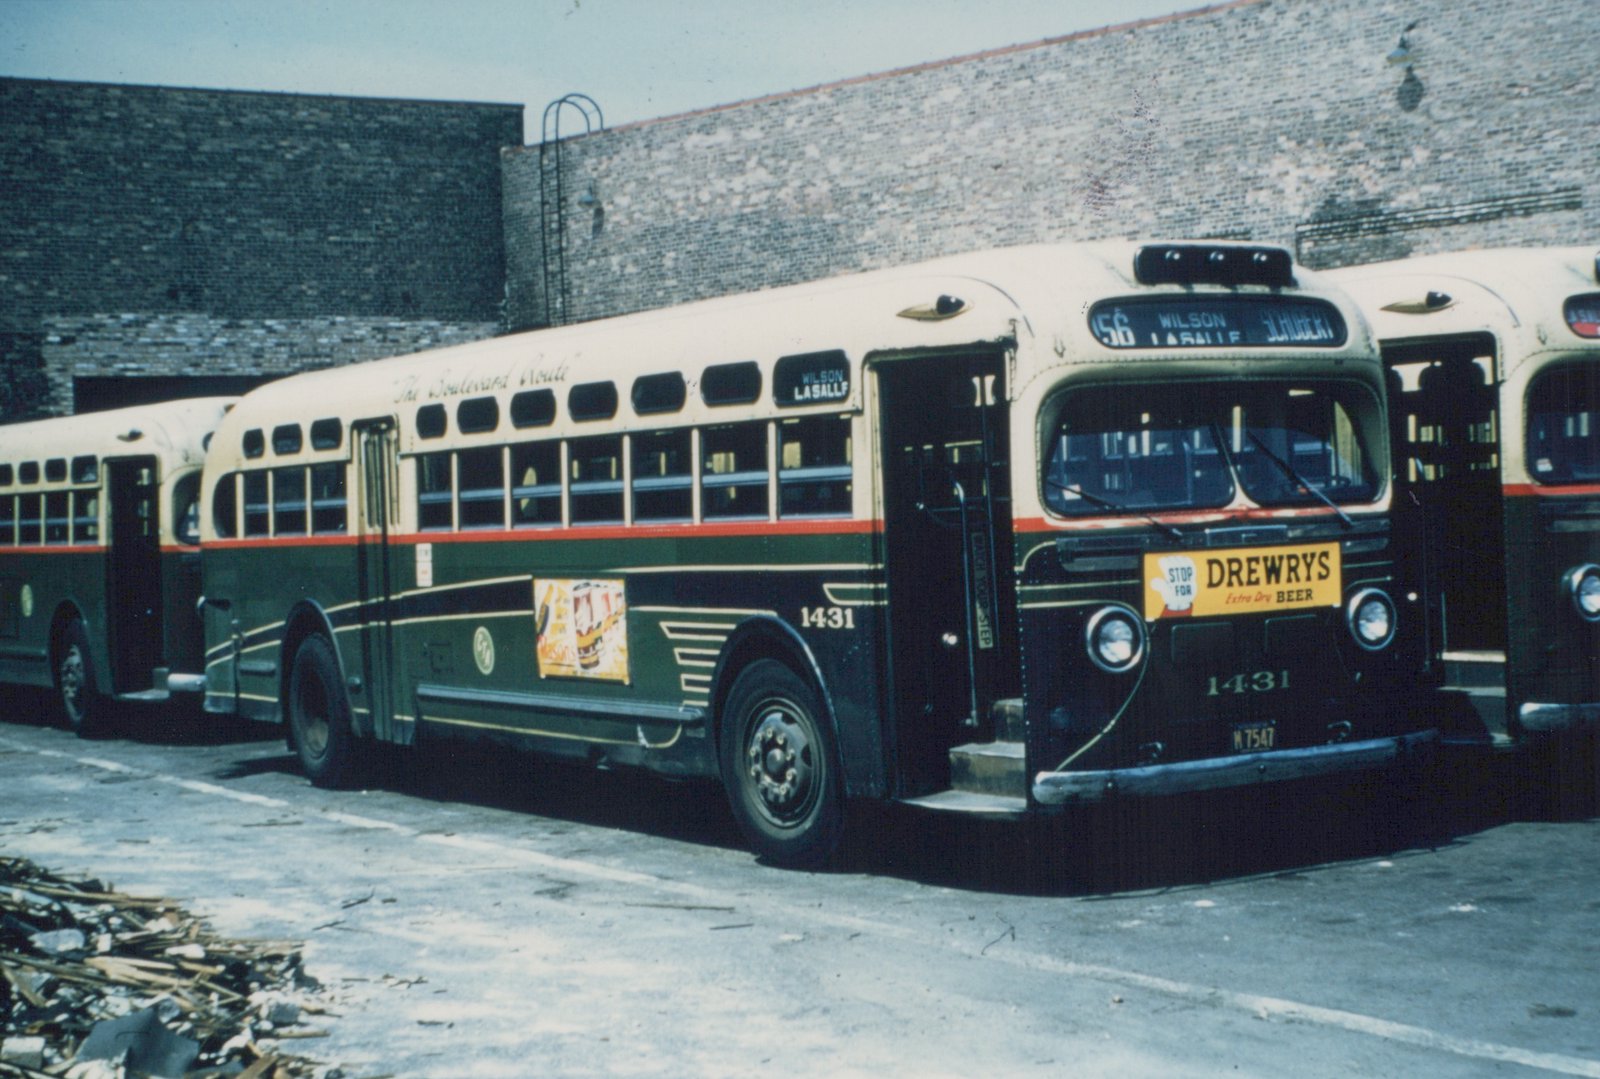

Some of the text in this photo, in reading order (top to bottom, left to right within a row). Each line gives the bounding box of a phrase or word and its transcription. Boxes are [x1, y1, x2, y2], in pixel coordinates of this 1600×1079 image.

[1159, 312, 1227, 329] WILSON
[802, 369, 844, 384] WILSON
[1168, 566, 1193, 583] STOP
[1206, 550, 1331, 589] DREWRYS
[1175, 584, 1193, 597] FOR
[1225, 588, 1314, 605] Extra Dry BEER
[801, 606, 855, 629] 1431
[1207, 670, 1290, 696] 1431
